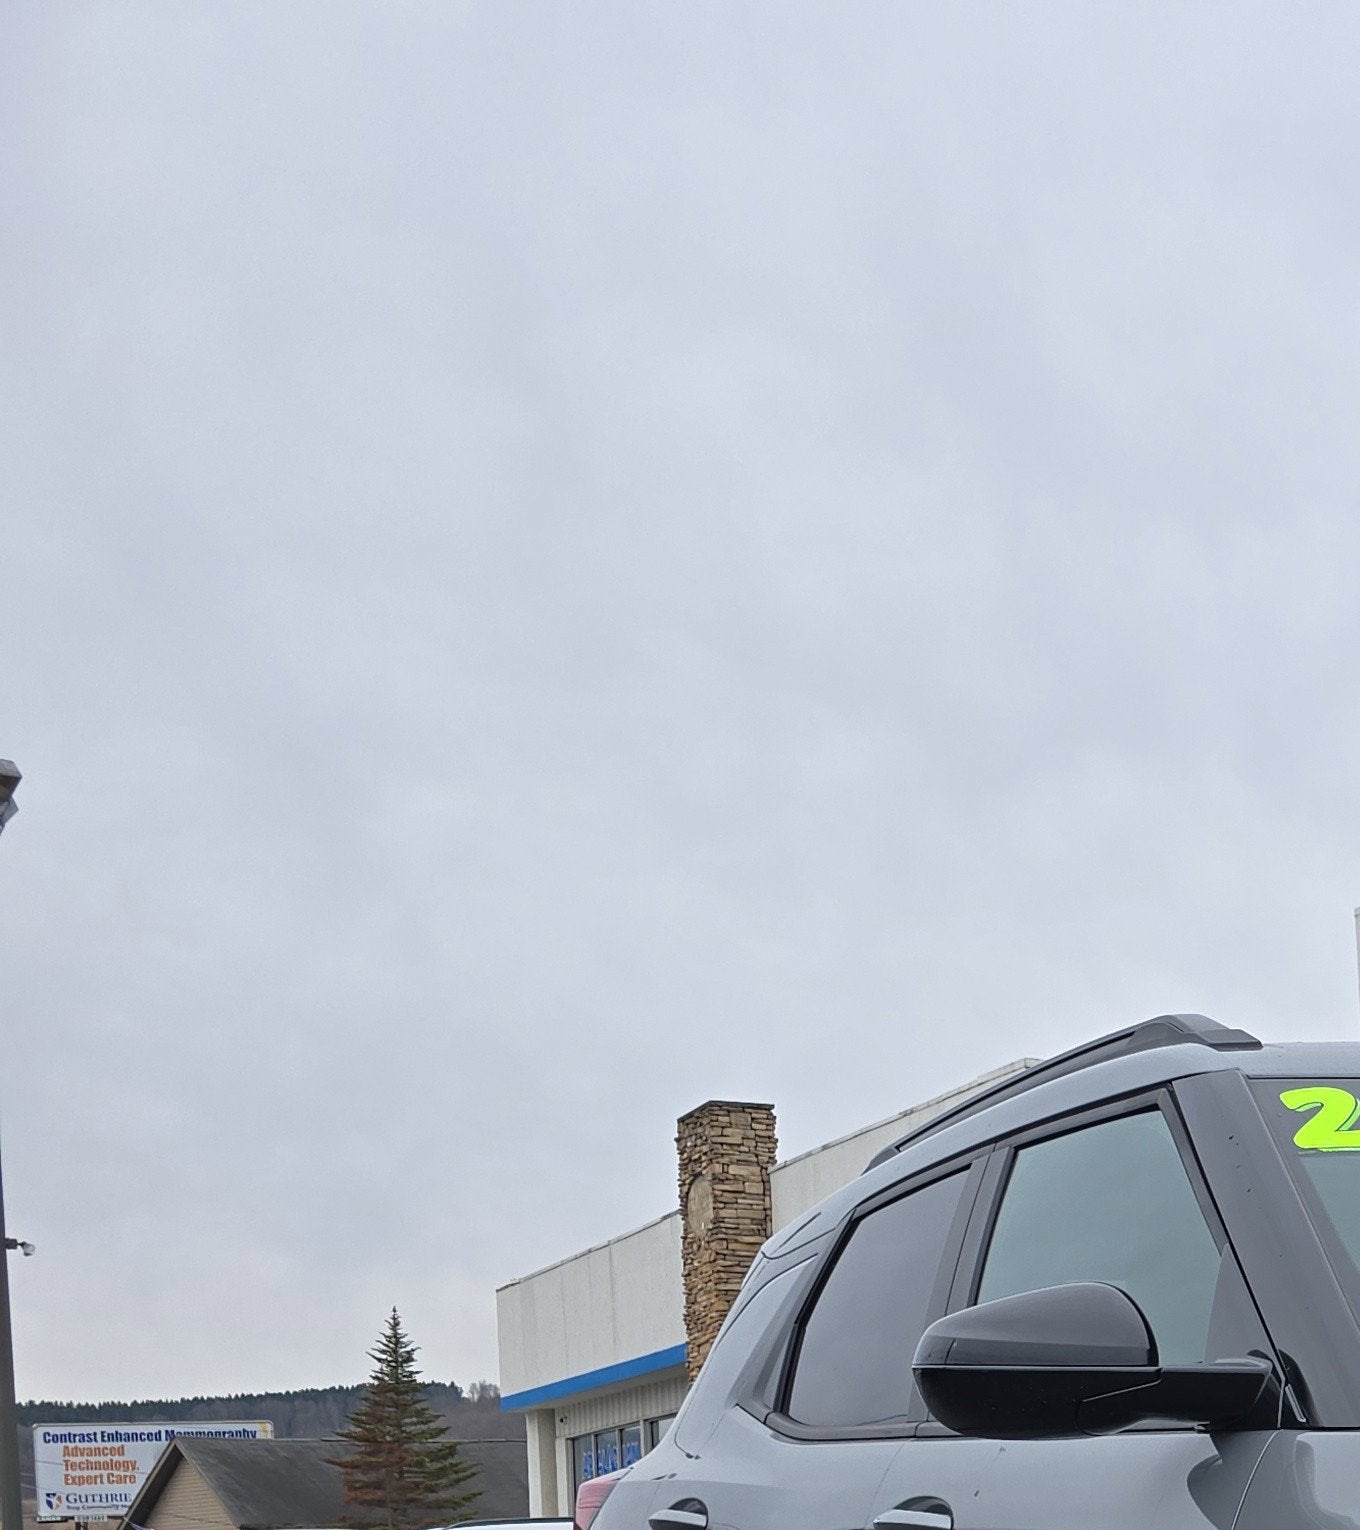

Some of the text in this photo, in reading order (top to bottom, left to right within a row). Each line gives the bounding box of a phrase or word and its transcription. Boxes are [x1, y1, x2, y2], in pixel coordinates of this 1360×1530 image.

[43, 1430, 98, 1444] Contrast
[100, 1429, 161, 1443] Enhanced
[63, 1444, 125, 1457] Advanced
[64, 1473, 136, 1486] Expert Care
[66, 1493, 132, 1504] GUTHRIE
